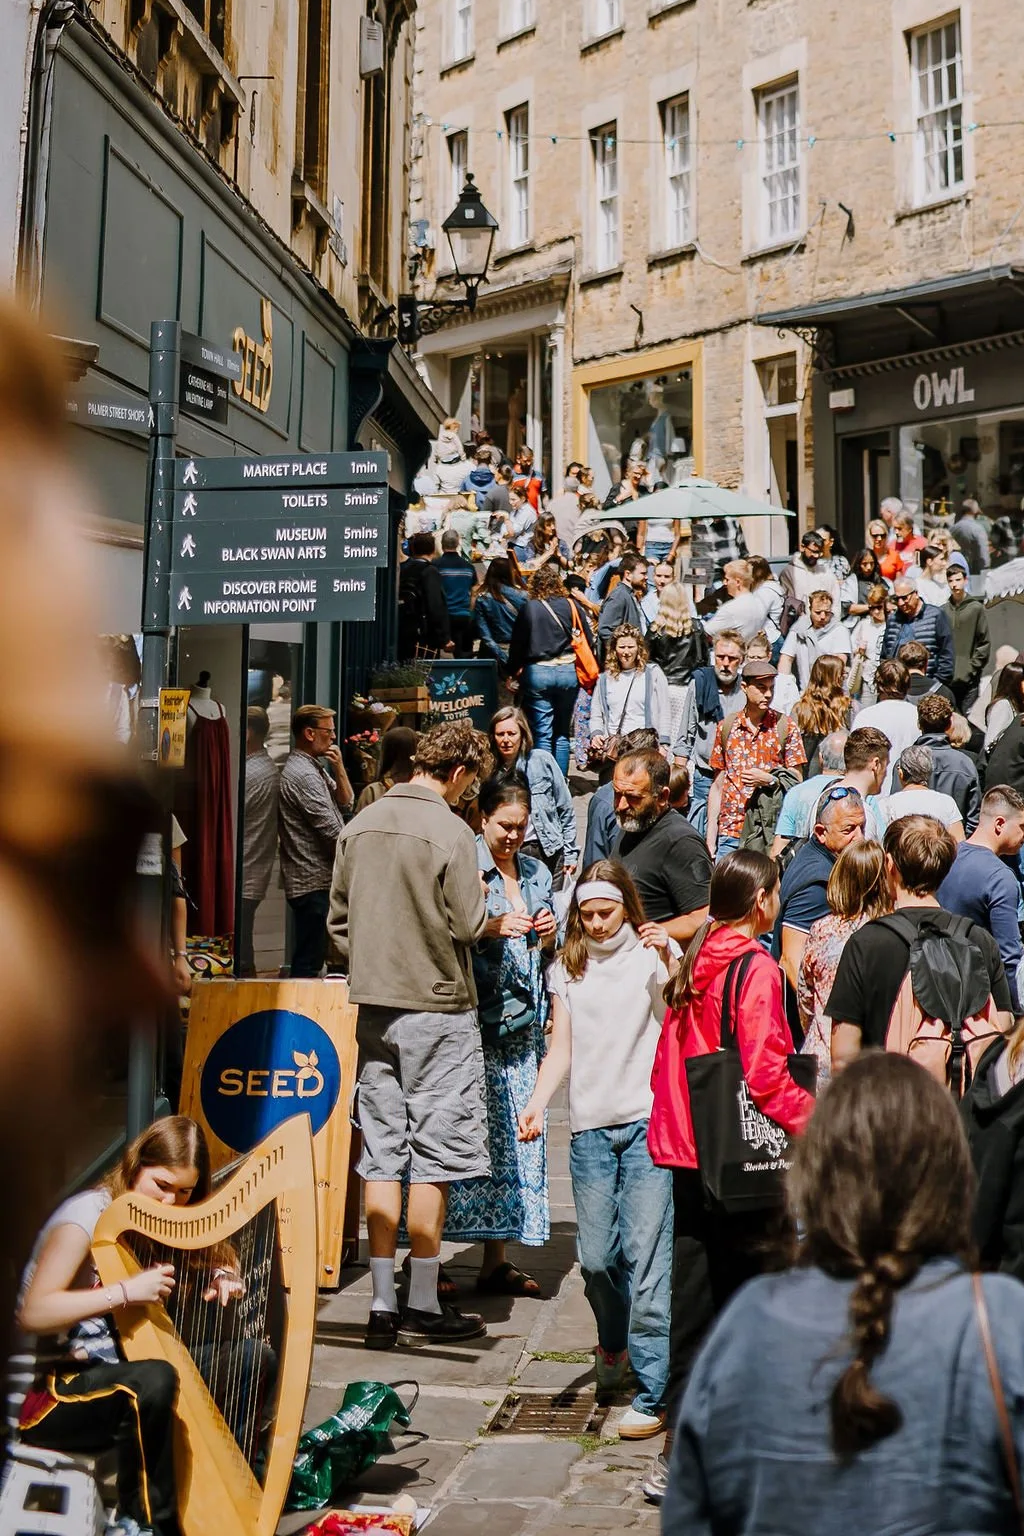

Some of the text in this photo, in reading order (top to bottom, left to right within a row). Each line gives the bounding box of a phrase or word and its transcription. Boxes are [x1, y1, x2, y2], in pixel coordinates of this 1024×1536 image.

[402, 313, 411, 327] 5
[231, 326, 273, 413] SEED
[913, 366, 975, 411] OWL
[87, 402, 109, 417] PALMER
[108, 407, 129, 421] STREET
[127, 410, 145, 423] SHOPS
[243, 461, 378, 477] MARKET PLACE 1min
[282, 492, 378, 508] TOILETS 5mins
[275, 526, 378, 542] MUSEUM 5mins
[221, 544, 378, 562] BLACK SWAN ARTS 5mins
[223, 579, 366, 595] DISCOVER FROME 5mins
[203, 598, 316, 615] INFORMATION POINT
[429, 695, 485, 713] WELCOME
[455, 710, 469, 719] THE
[218, 1063, 324, 1099] SEED
